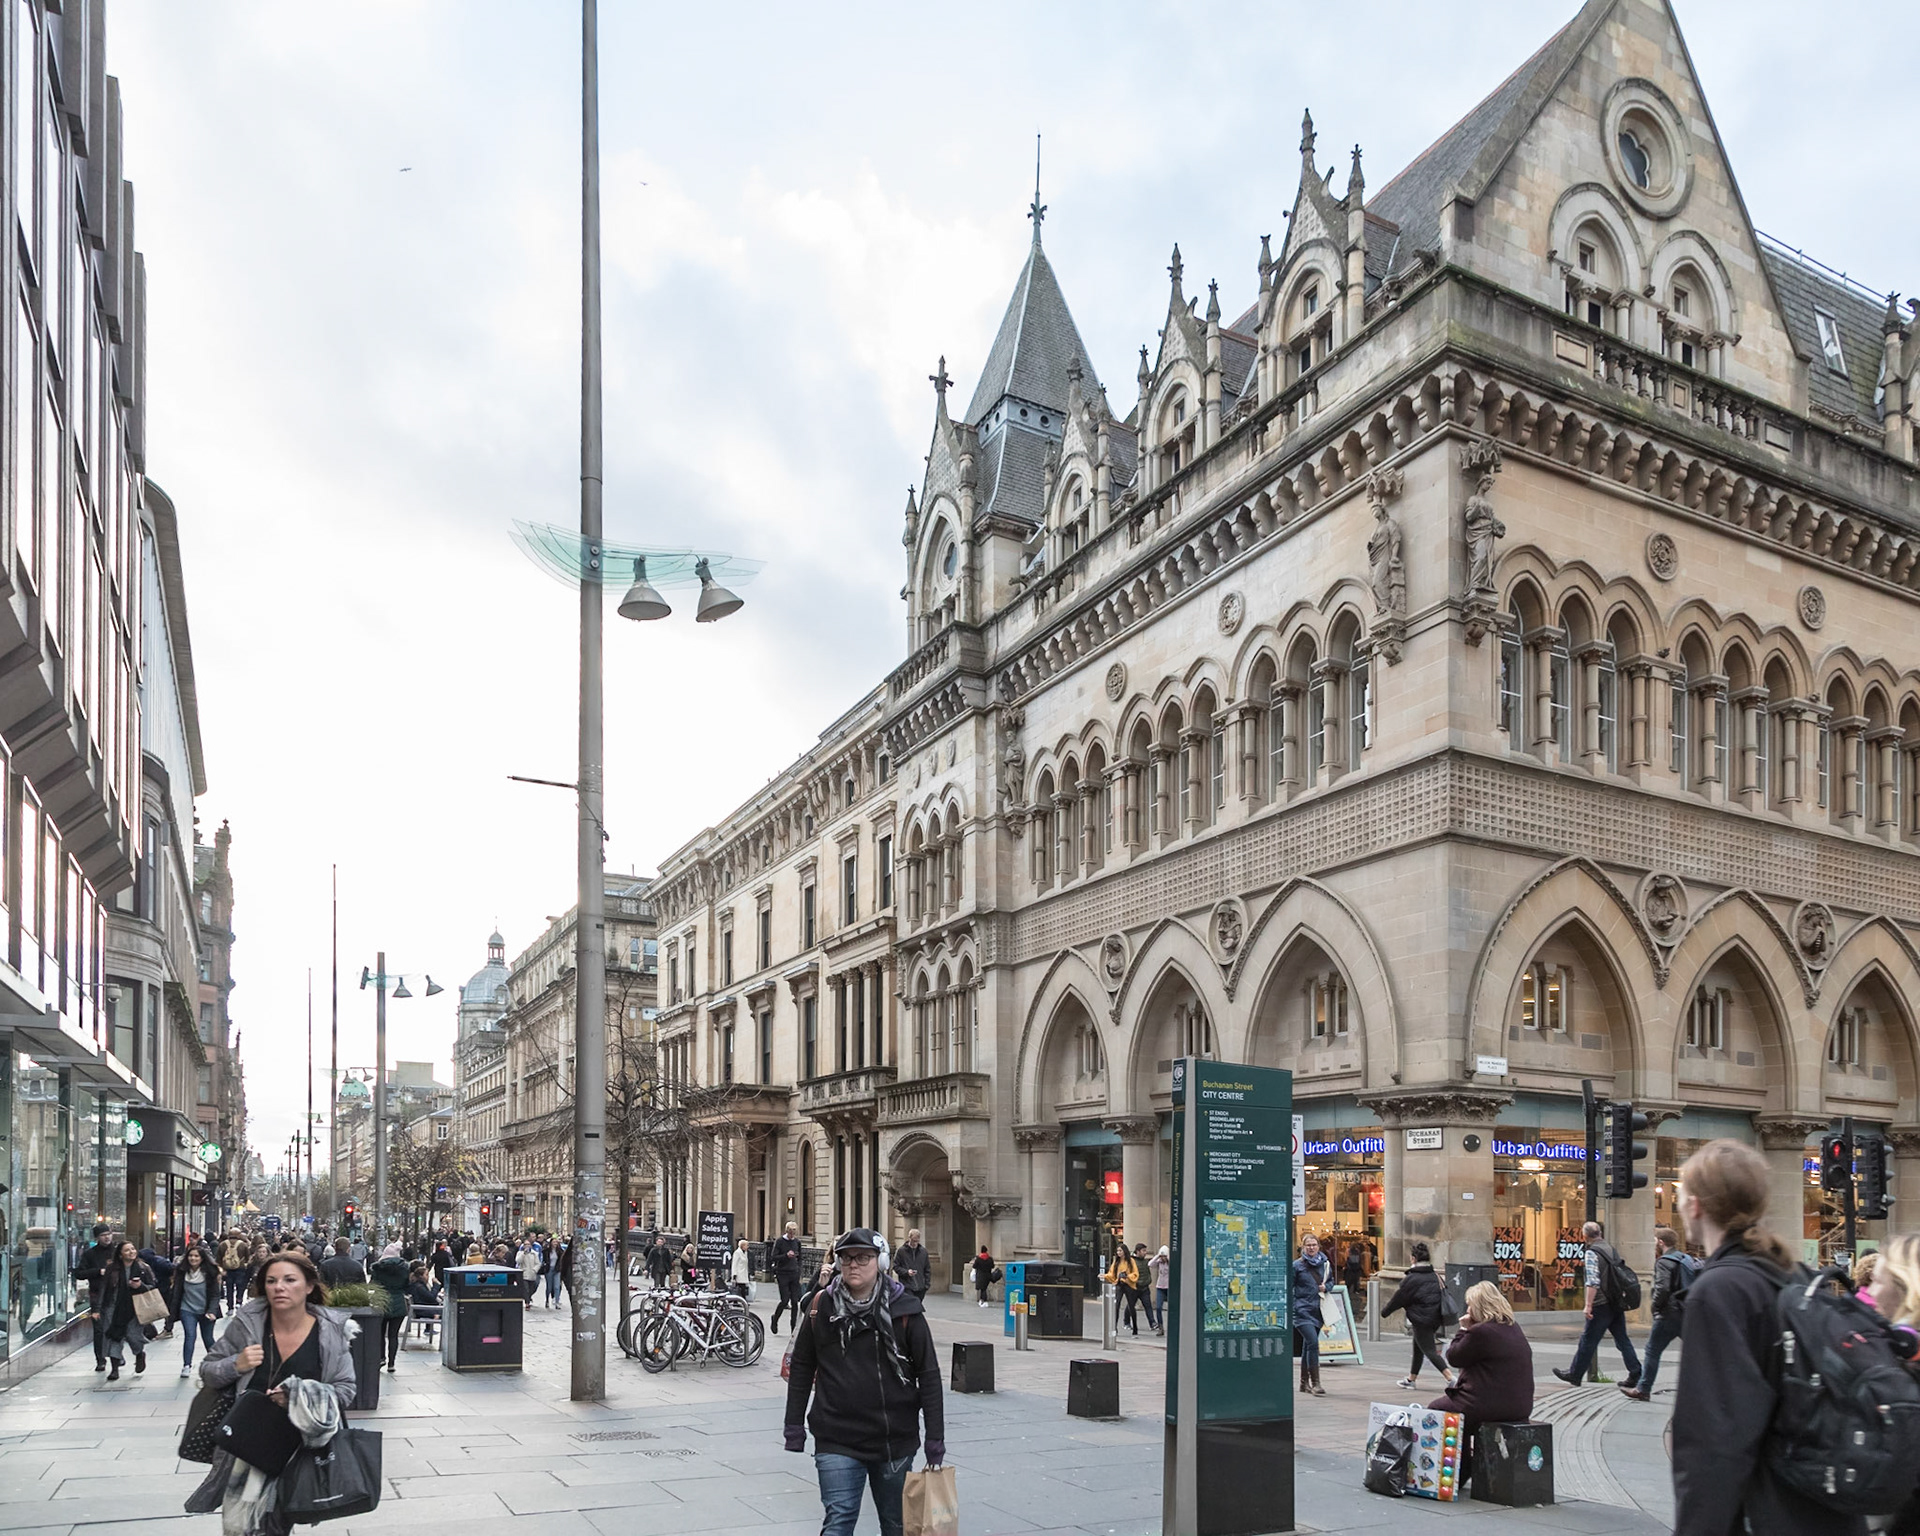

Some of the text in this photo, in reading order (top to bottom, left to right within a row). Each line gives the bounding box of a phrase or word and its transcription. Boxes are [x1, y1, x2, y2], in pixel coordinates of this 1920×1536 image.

[1203, 1080, 1253, 1090] Buchanan Street
[1218, 1092, 1244, 1100] CENTRE
[1304, 1138, 1384, 1155] Urban Outfitt
[1492, 1140, 1600, 1160] Urban Outfittes
[705, 1215, 726, 1223] Apple
[702, 1235, 728, 1243] Repairs
[1494, 1243, 1521, 1259] 30%
[1558, 1243, 1584, 1259] 30%
